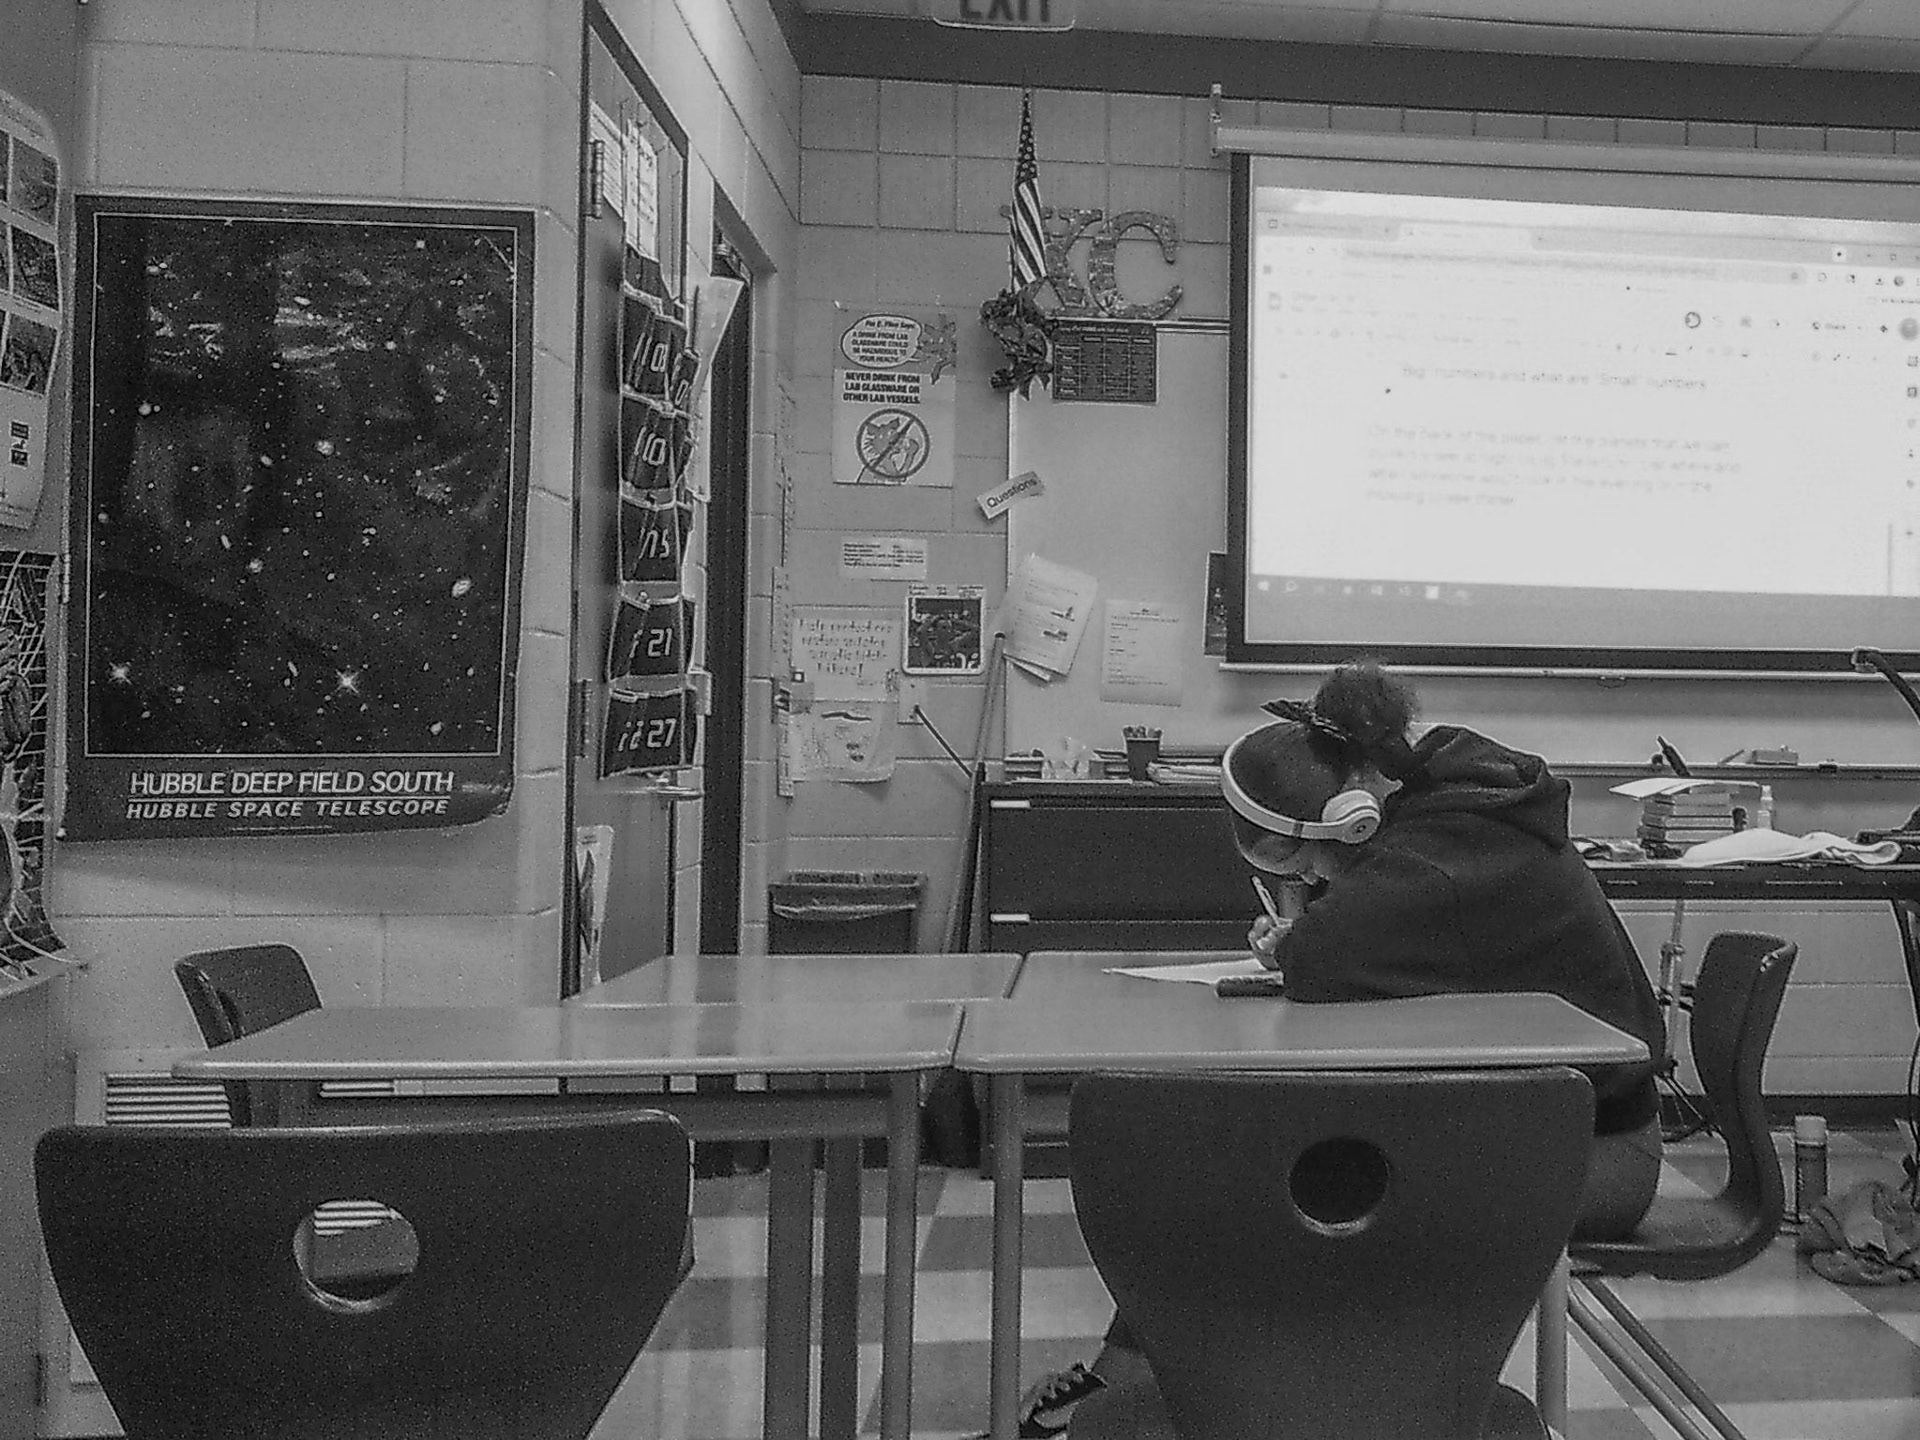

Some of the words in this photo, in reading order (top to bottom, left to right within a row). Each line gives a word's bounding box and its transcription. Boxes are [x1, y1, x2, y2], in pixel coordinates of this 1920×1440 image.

[845, 382, 860, 391] LAB
[862, 383, 907, 392] GLASSWARE
[909, 385, 920, 393] OR
[846, 373, 871, 381] NEVER
[872, 373, 896, 382] DRINK
[897, 375, 920, 383] FROM
[843, 393, 868, 401] OTHER
[870, 394, 885, 402] LAB
[986, 476, 1038, 508] Questions
[648, 628, 673, 657] 21
[647, 719, 677, 748] 27
[130, 772, 225, 795] HUBBLE
[231, 771, 293, 794] DEEP
[298, 771, 365, 793] FIELD
[369, 771, 454, 793] SOUTH
[126, 801, 218, 819] HUBBLE
[228, 800, 303, 818] SPACE
[317, 799, 449, 817] TELESCOPE
